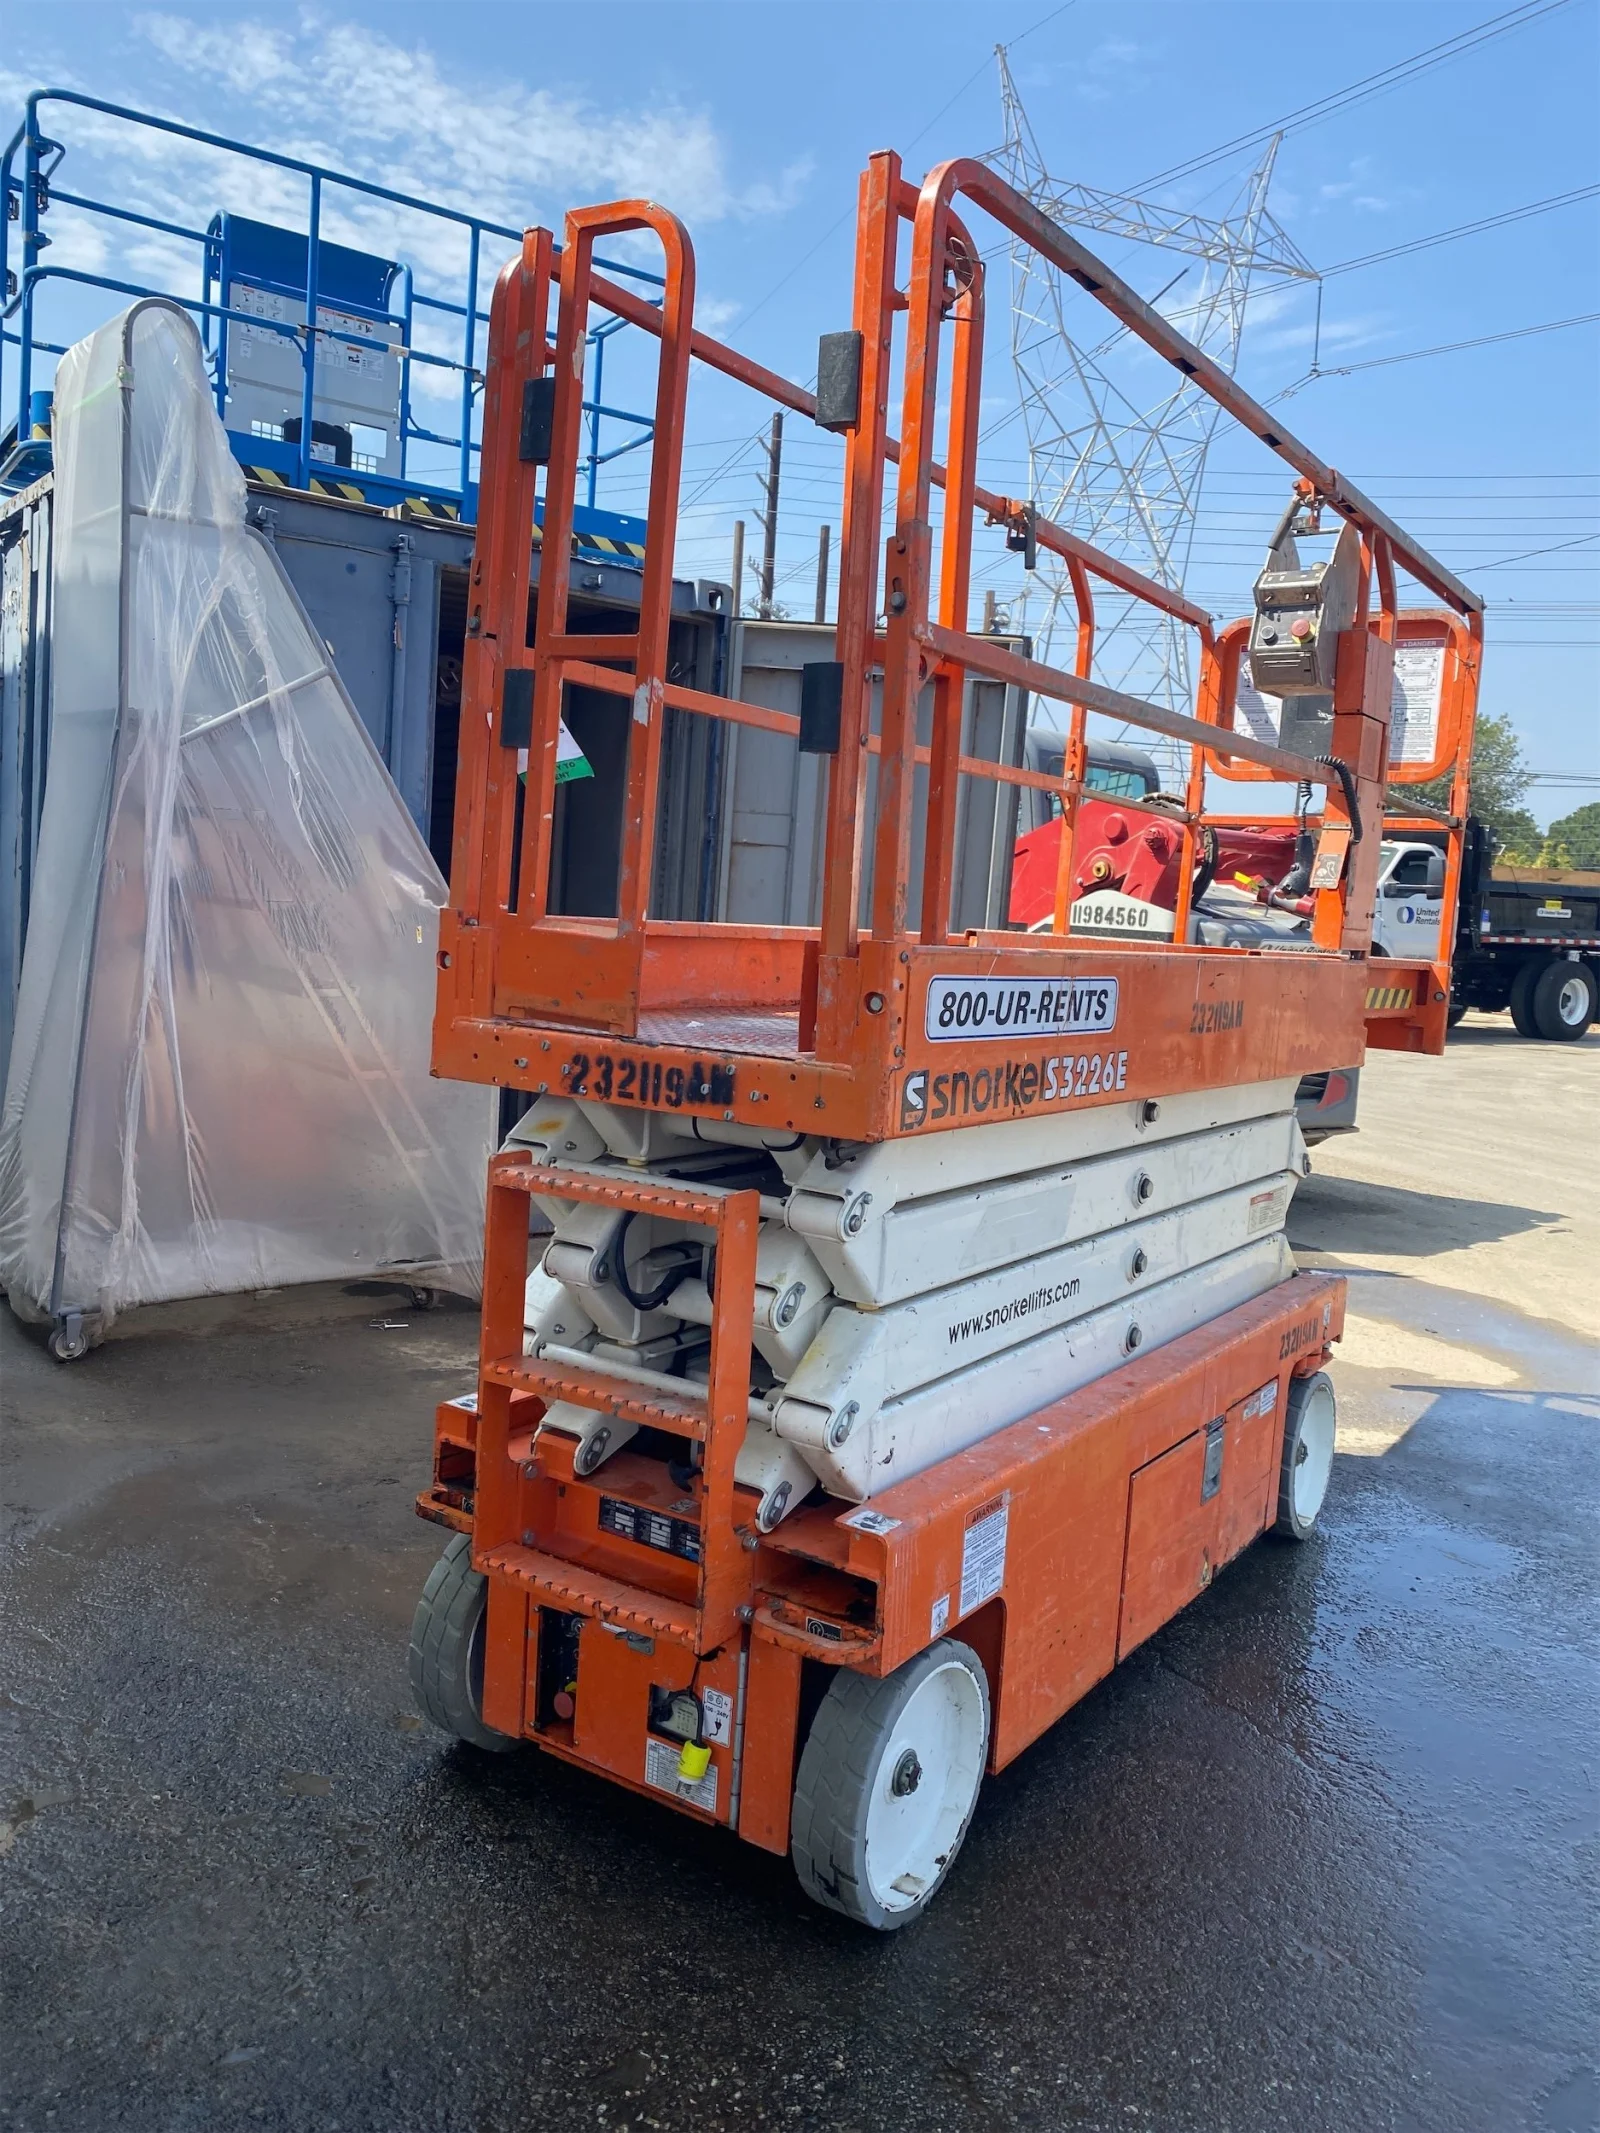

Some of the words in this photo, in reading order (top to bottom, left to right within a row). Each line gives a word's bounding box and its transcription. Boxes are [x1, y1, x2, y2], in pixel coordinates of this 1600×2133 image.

[1072, 904, 1149, 928] 11984560
[1415, 917, 1441, 926] Rentals
[1416, 907, 1440, 917] United
[938, 988, 1110, 1028] 800-UR-RENTS
[931, 1056, 1047, 1120] snorkel
[1044, 1050, 1129, 1101] S3226E
[948, 1278, 1081, 1345] www.snorkellifts.com
